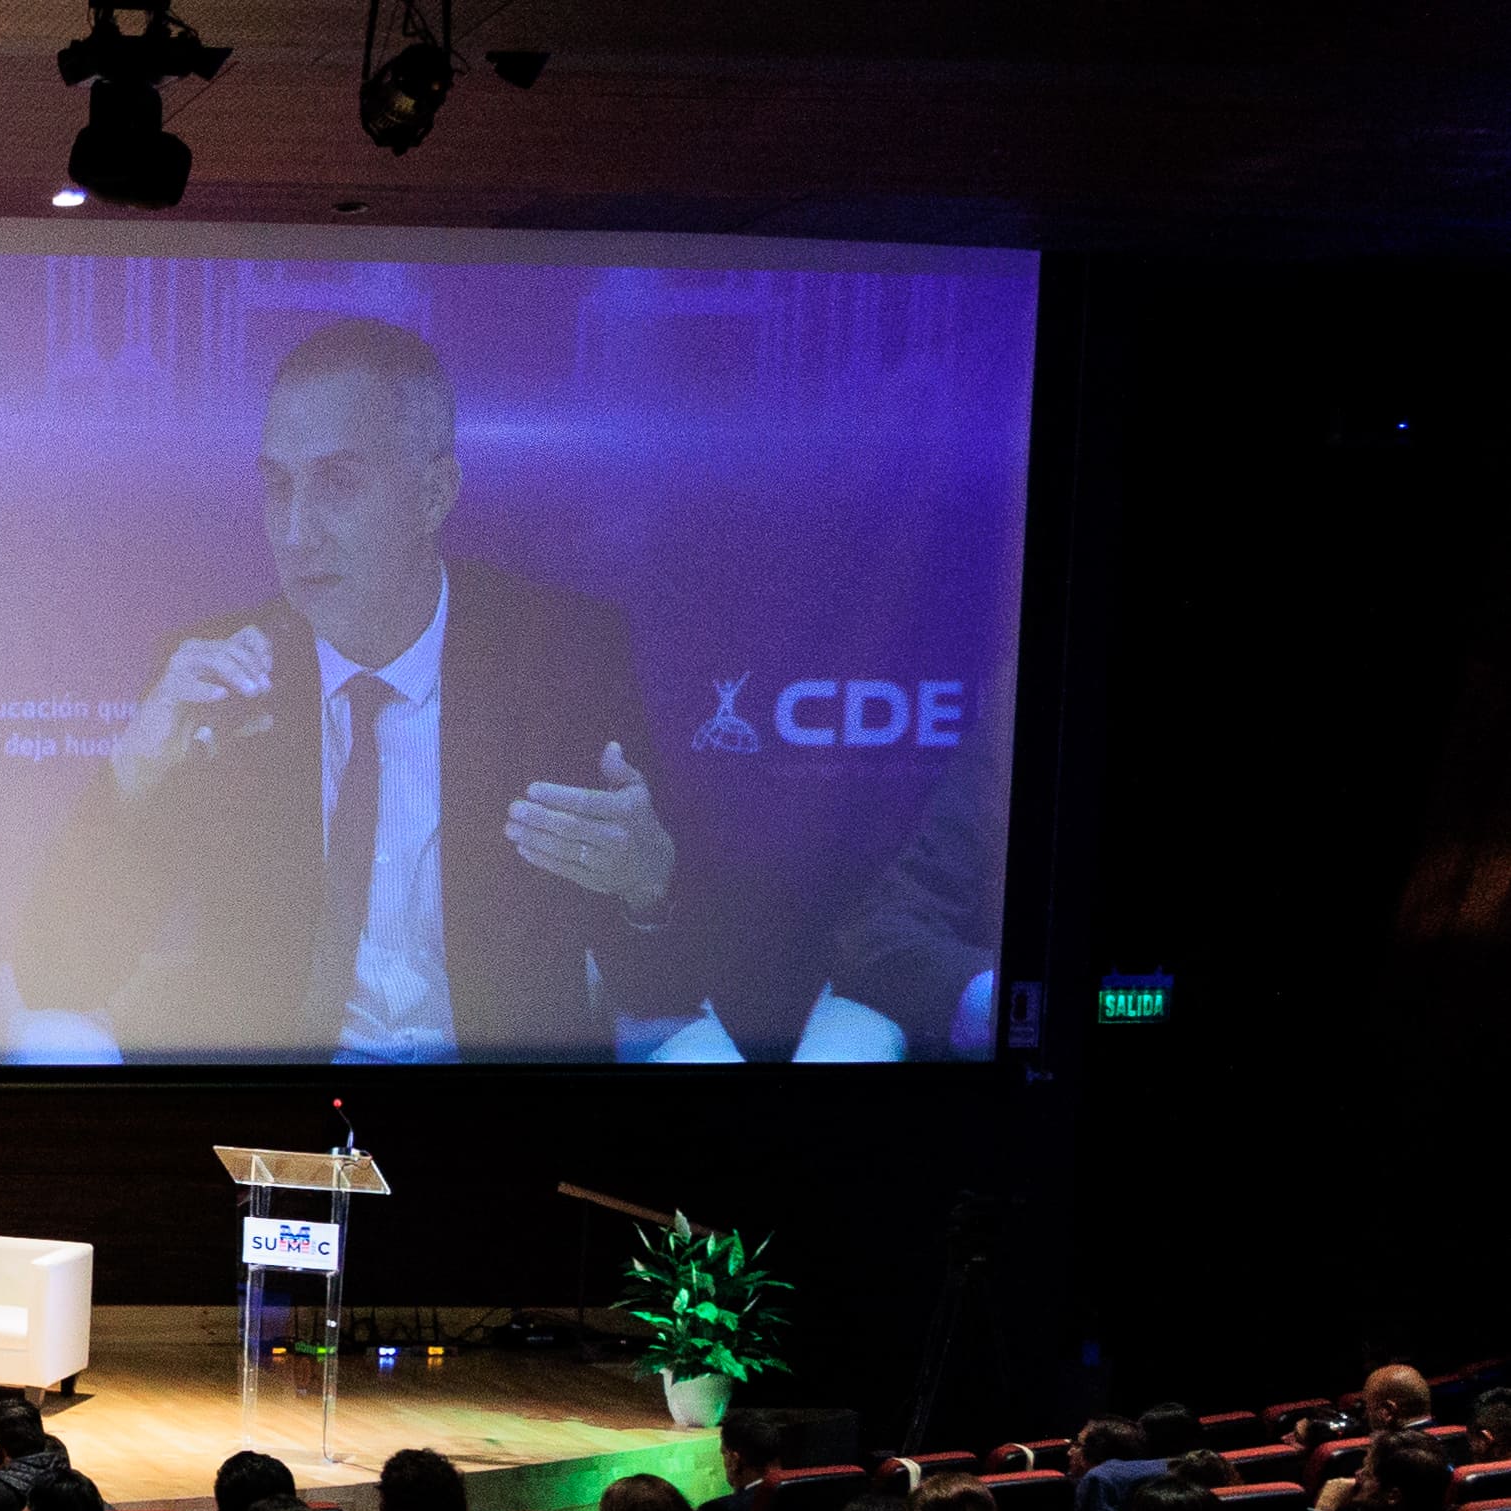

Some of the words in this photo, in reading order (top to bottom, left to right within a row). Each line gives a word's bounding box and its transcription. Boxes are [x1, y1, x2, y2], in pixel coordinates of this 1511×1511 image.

[775, 680, 962, 747] CDE
[3, 731, 58, 763] deja
[1105, 994, 1163, 1017] SALIDA
